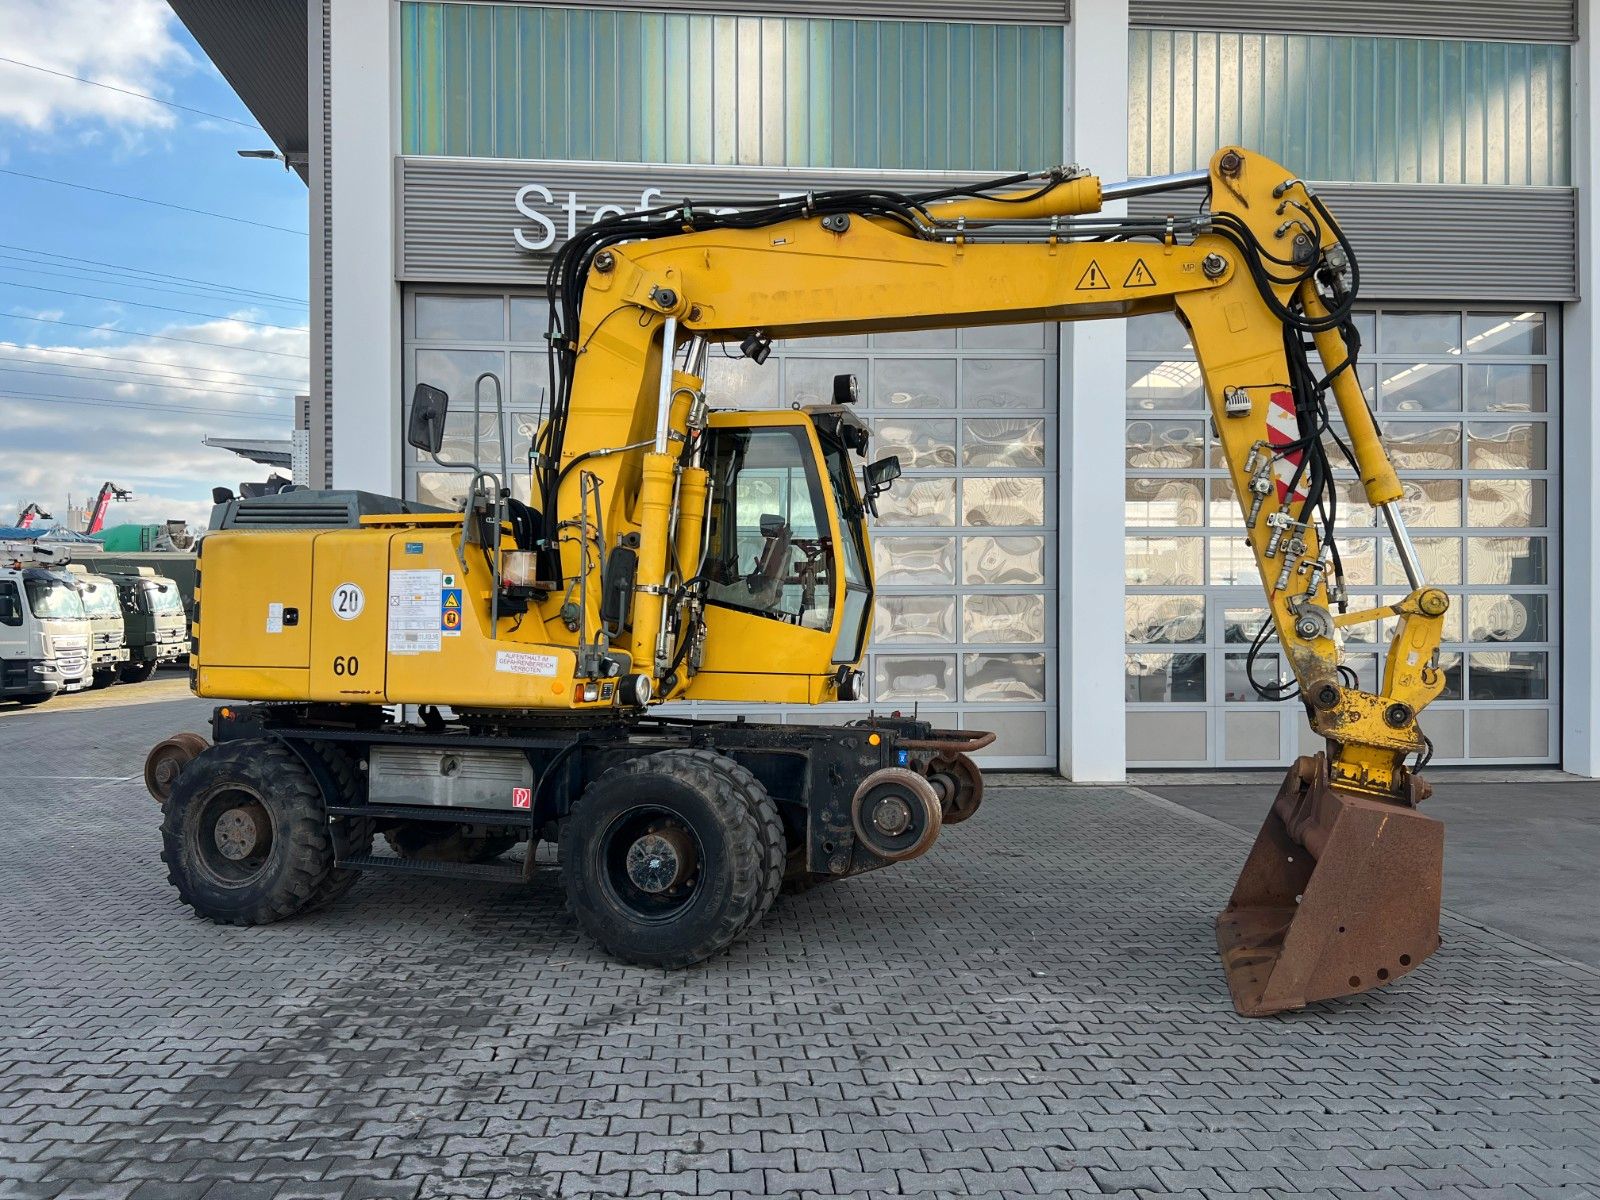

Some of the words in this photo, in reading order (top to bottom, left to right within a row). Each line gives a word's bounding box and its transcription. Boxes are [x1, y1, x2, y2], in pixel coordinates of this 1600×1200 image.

[338, 590, 358, 612] 20
[505, 653, 541, 661] AUFENTHALT
[333, 655, 359, 676] 60
[499, 658, 554, 668] GEFAHRENBEREICH
[510, 665, 541, 673] VERBOTEN
